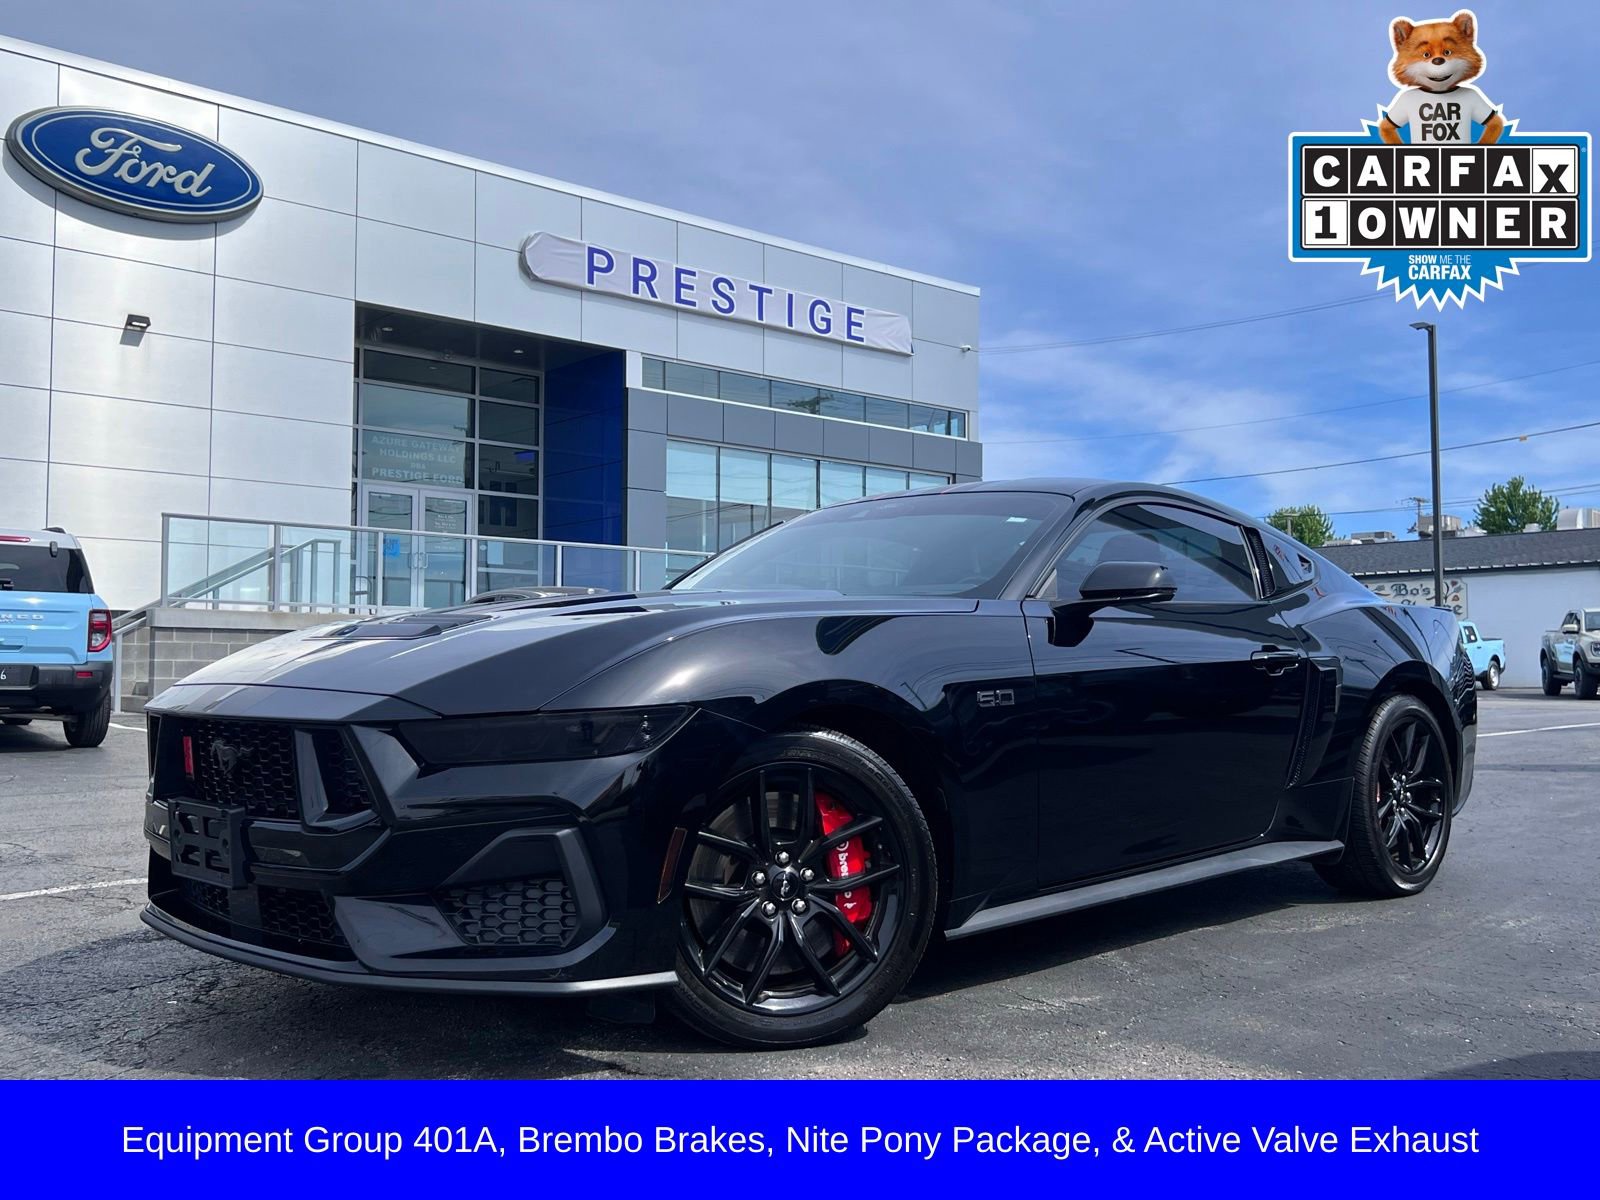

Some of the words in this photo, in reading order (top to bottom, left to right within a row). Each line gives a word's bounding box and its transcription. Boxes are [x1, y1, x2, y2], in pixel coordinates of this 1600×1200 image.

[75, 127, 215, 198] Ford
[586, 245, 865, 343] PRESTIGE
[371, 467, 432, 481] PRESTIGE
[432, 472, 464, 484] FORD
[379, 447, 435, 461] HOLDINGS
[437, 454, 457, 464] LLC
